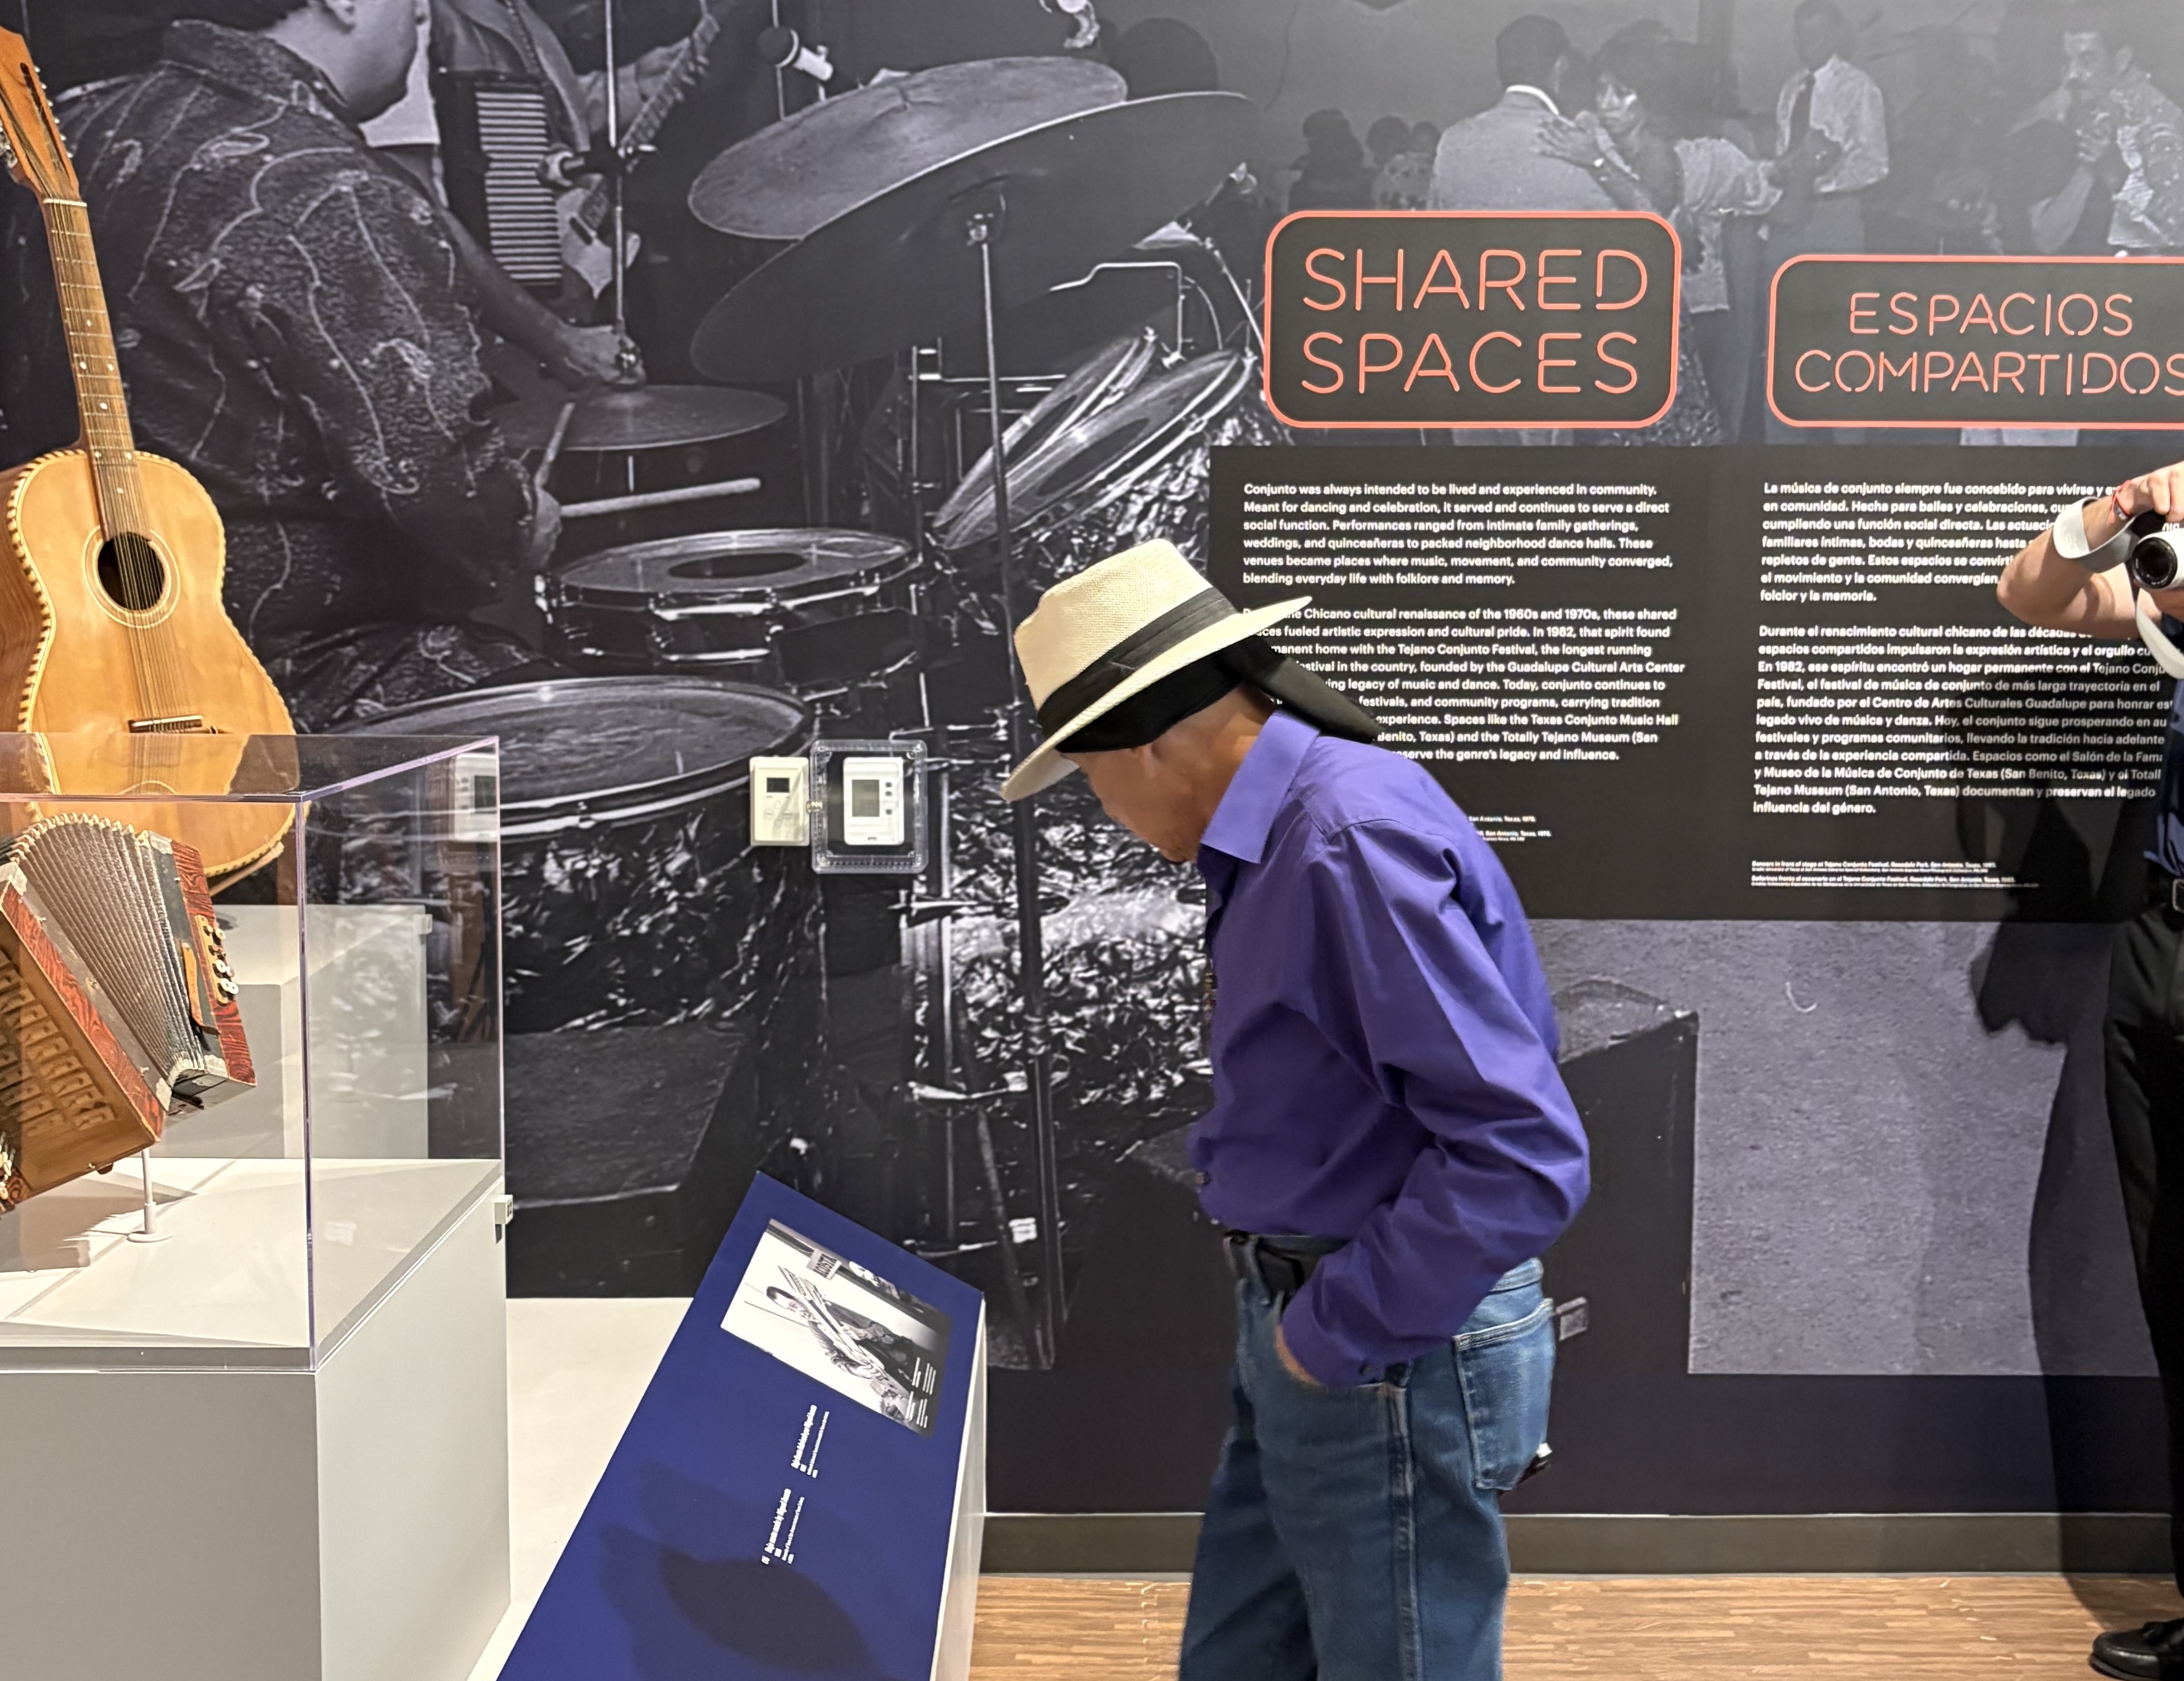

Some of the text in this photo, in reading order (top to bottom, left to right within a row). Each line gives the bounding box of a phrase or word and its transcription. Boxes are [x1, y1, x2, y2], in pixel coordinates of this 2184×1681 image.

[1303, 248, 1648, 311] SHARED
[1849, 293, 2132, 336] ESPACIOS
[1302, 331, 1637, 395] SPACES
[1795, 350, 2184, 396] COMPARTIDOS
[1244, 483, 1656, 496] Conjunto was always intended to be lived and experienced in community.
[1764, 482, 2103, 498] La música de conjunto siempre fue concebido para vivirse y
[1244, 501, 1669, 514] Meant for dancing and celebration, it served and continues to serve a direct
[1763, 500, 2048, 514] en comunidad. Hecha para bailes y celebraciones,
[1244, 519, 1638, 533] social function. Performances ranged from intimate family gatherings,
[1763, 518, 2006, 531] cumpliendo una función social directa. Las
[1244, 537, 1653, 550] weddings, and quinceañeras to packed neighborhood dance halls. These
[1286, 555, 1331, 566] became
[1334, 555, 1370, 567] places
[1373, 555, 1409, 566] where
[1411, 556, 1447, 567] music,
[1451, 557, 1514, 567] movement,
[1517, 555, 1539, 566] and
[1541, 555, 1606, 568] community
[1608, 555, 1672, 568] converged,
[1243, 572, 1515, 586] blending everyday life with folklore and memory.
[1304, 608, 1677, 620] Chicano cultural renaissance of the 1960s and 1970s, these shared
[1284, 625, 1670, 639] fueled artistic expression and cultural pride. In 1982, that spirit found
[1758, 661, 1773, 672] En
[1775, 661, 1805, 673] 1982,
[1808, 663, 1829, 672] ese
[1831, 661, 1875, 674] espíritu
[1877, 661, 1930, 672] encontró
[1931, 664, 1946, 672] un
[1948, 661, 1982, 675] hogar
[1984, 664, 2053, 675] permanente
[2079, 662, 2090, 672] el
[2093, 663, 2129, 674] Tejano
[1758, 678, 1804, 691] Festival,
[1807, 678, 1818, 690] el
[1820, 678, 1862, 690] festival
[1863, 678, 1879, 690] de
[1881, 679, 1922, 690] música
[1924, 679, 1940, 690] de
[1941, 679, 1992, 692] conjunto
[1995, 680, 2009, 690] de
[2012, 680, 2035, 690] más
[2038, 680, 2066, 693] larga
[2069, 681, 2130, 693] trayectoria
[2150, 681, 2160, 691] el
